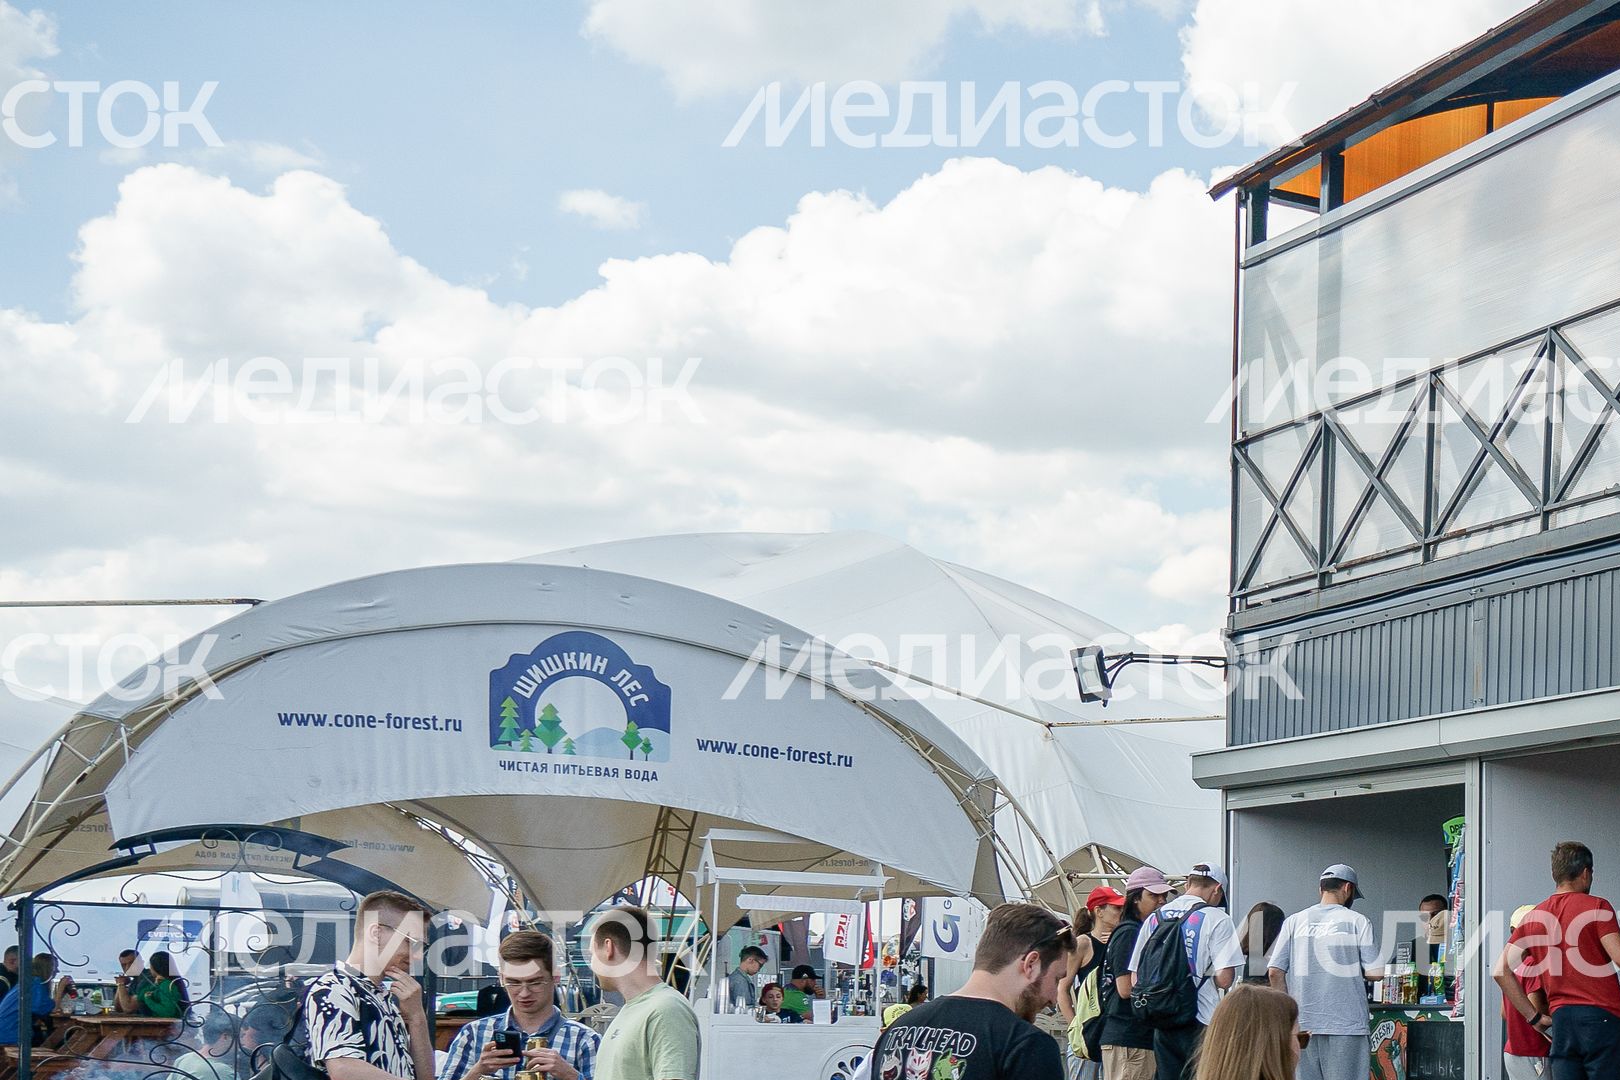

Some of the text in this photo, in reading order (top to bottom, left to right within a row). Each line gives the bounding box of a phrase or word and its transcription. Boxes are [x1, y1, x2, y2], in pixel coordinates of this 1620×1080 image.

[512, 652, 649, 707] ШИШКИН ЛЕС
[277, 712, 463, 732] www.cone-forest.ru
[696, 738, 853, 768] www.cone-forest.ru
[499, 759, 659, 783] ЧИСТАЯ ПИТЬЕВАЯ ВОДА
[1371, 1024, 1392, 1049] FRESH
